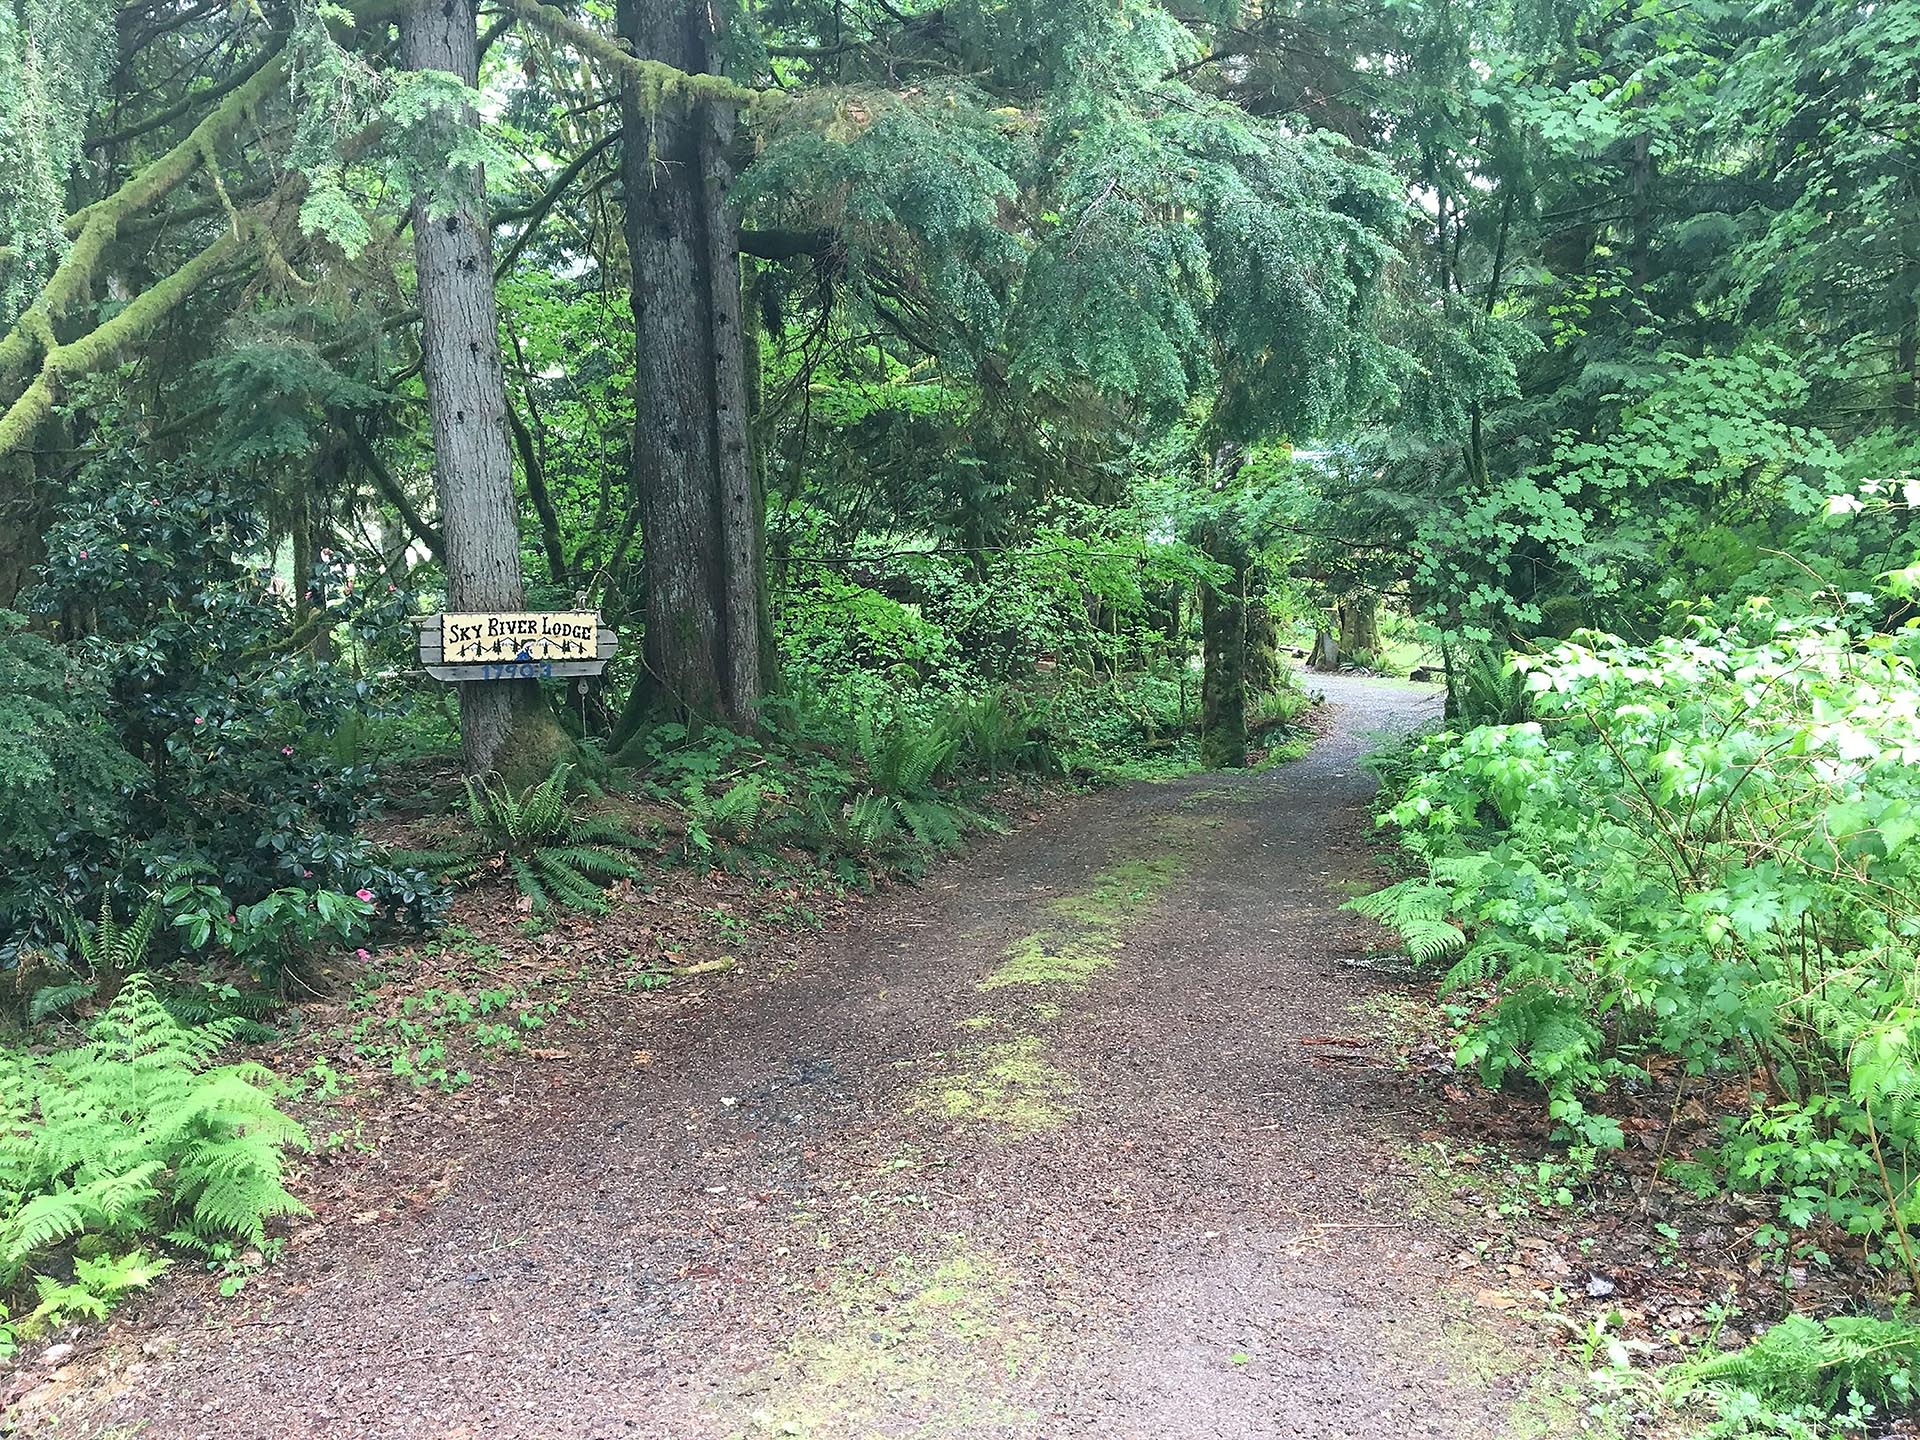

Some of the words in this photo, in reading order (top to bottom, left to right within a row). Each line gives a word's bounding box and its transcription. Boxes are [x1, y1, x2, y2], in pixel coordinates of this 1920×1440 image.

[450, 624, 483, 643] SKY
[488, 617, 537, 636] RIVER
[542, 616, 592, 640] LODGE
